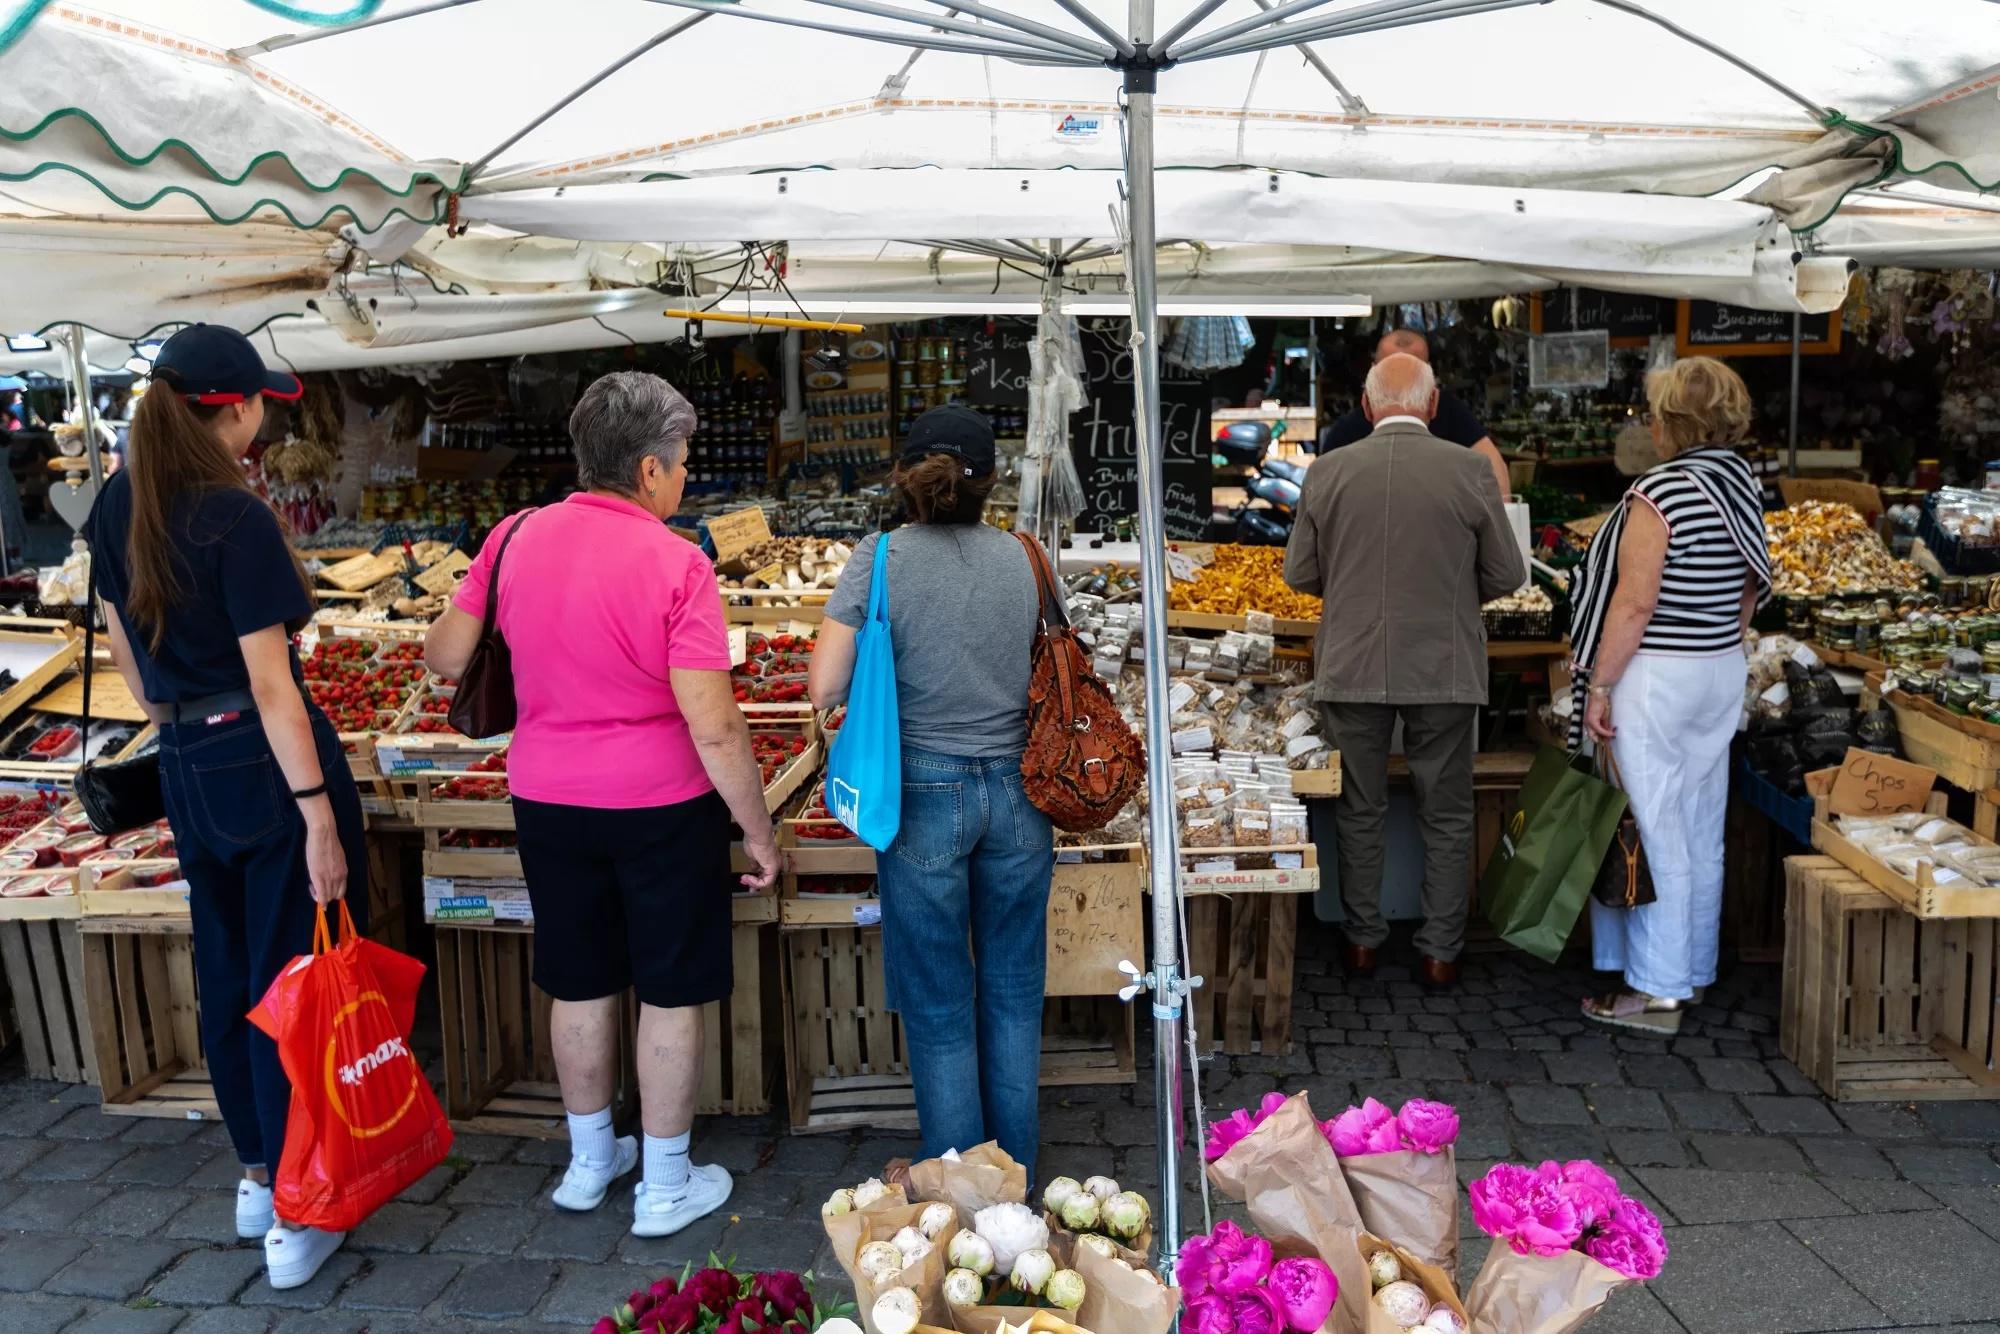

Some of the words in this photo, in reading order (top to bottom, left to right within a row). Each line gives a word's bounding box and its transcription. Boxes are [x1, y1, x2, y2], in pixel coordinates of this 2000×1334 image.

[1847, 755, 1906, 791] Chips
[1194, 876, 1212, 885] DE
[1216, 874, 1256, 885] CARLI
